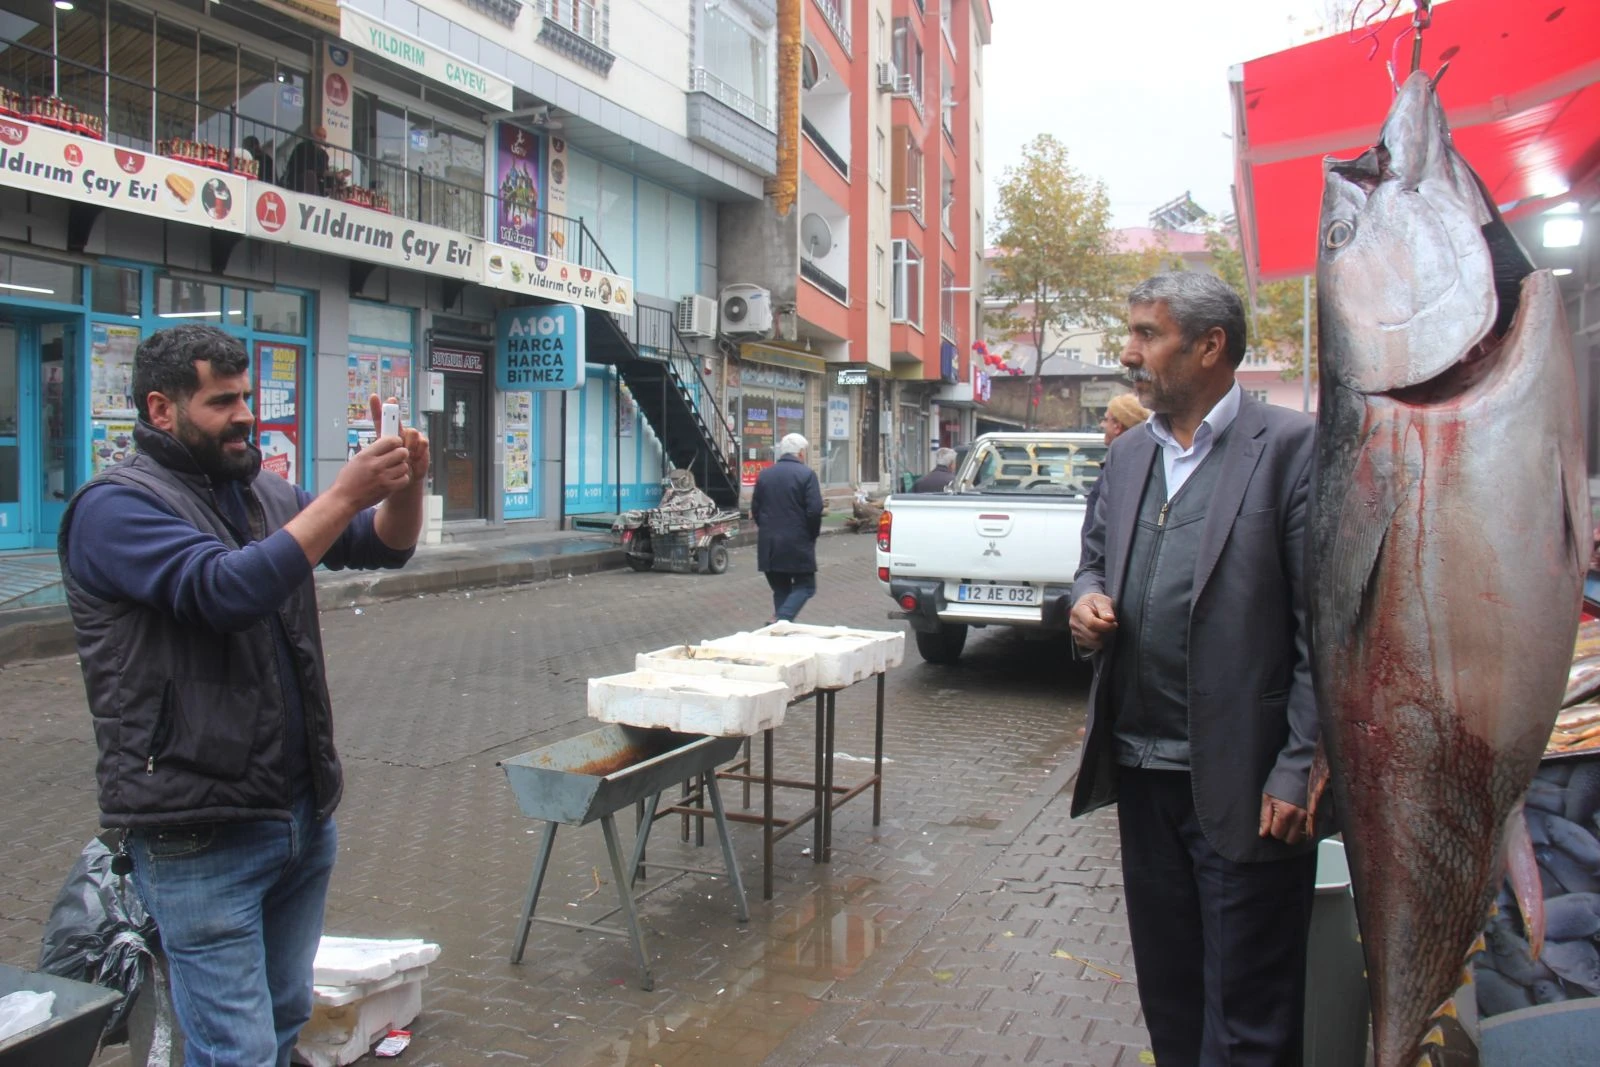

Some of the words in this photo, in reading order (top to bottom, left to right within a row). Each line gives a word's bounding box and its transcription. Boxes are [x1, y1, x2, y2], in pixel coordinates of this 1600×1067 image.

[369, 26, 425, 67] YILDIRIM
[82, 169, 121, 199] Çay
[128, 179, 158, 202] Evi
[298, 202, 393, 250] Yıldırım
[401, 229, 440, 265] Çay
[446, 239, 473, 267] Evi
[528, 272, 564, 292] Yıldırım
[566, 281, 583, 299] Çay
[584, 286, 598, 300] Evi
[508, 337, 564, 353] HARCA
[508, 353, 564, 368] HARCA
[261, 389, 290, 405] HEP
[261, 402, 296, 421] UCUZ
[967, 587, 981, 600] 12
[987, 588, 1003, 601] AE
[1008, 588, 1034, 602] 032
